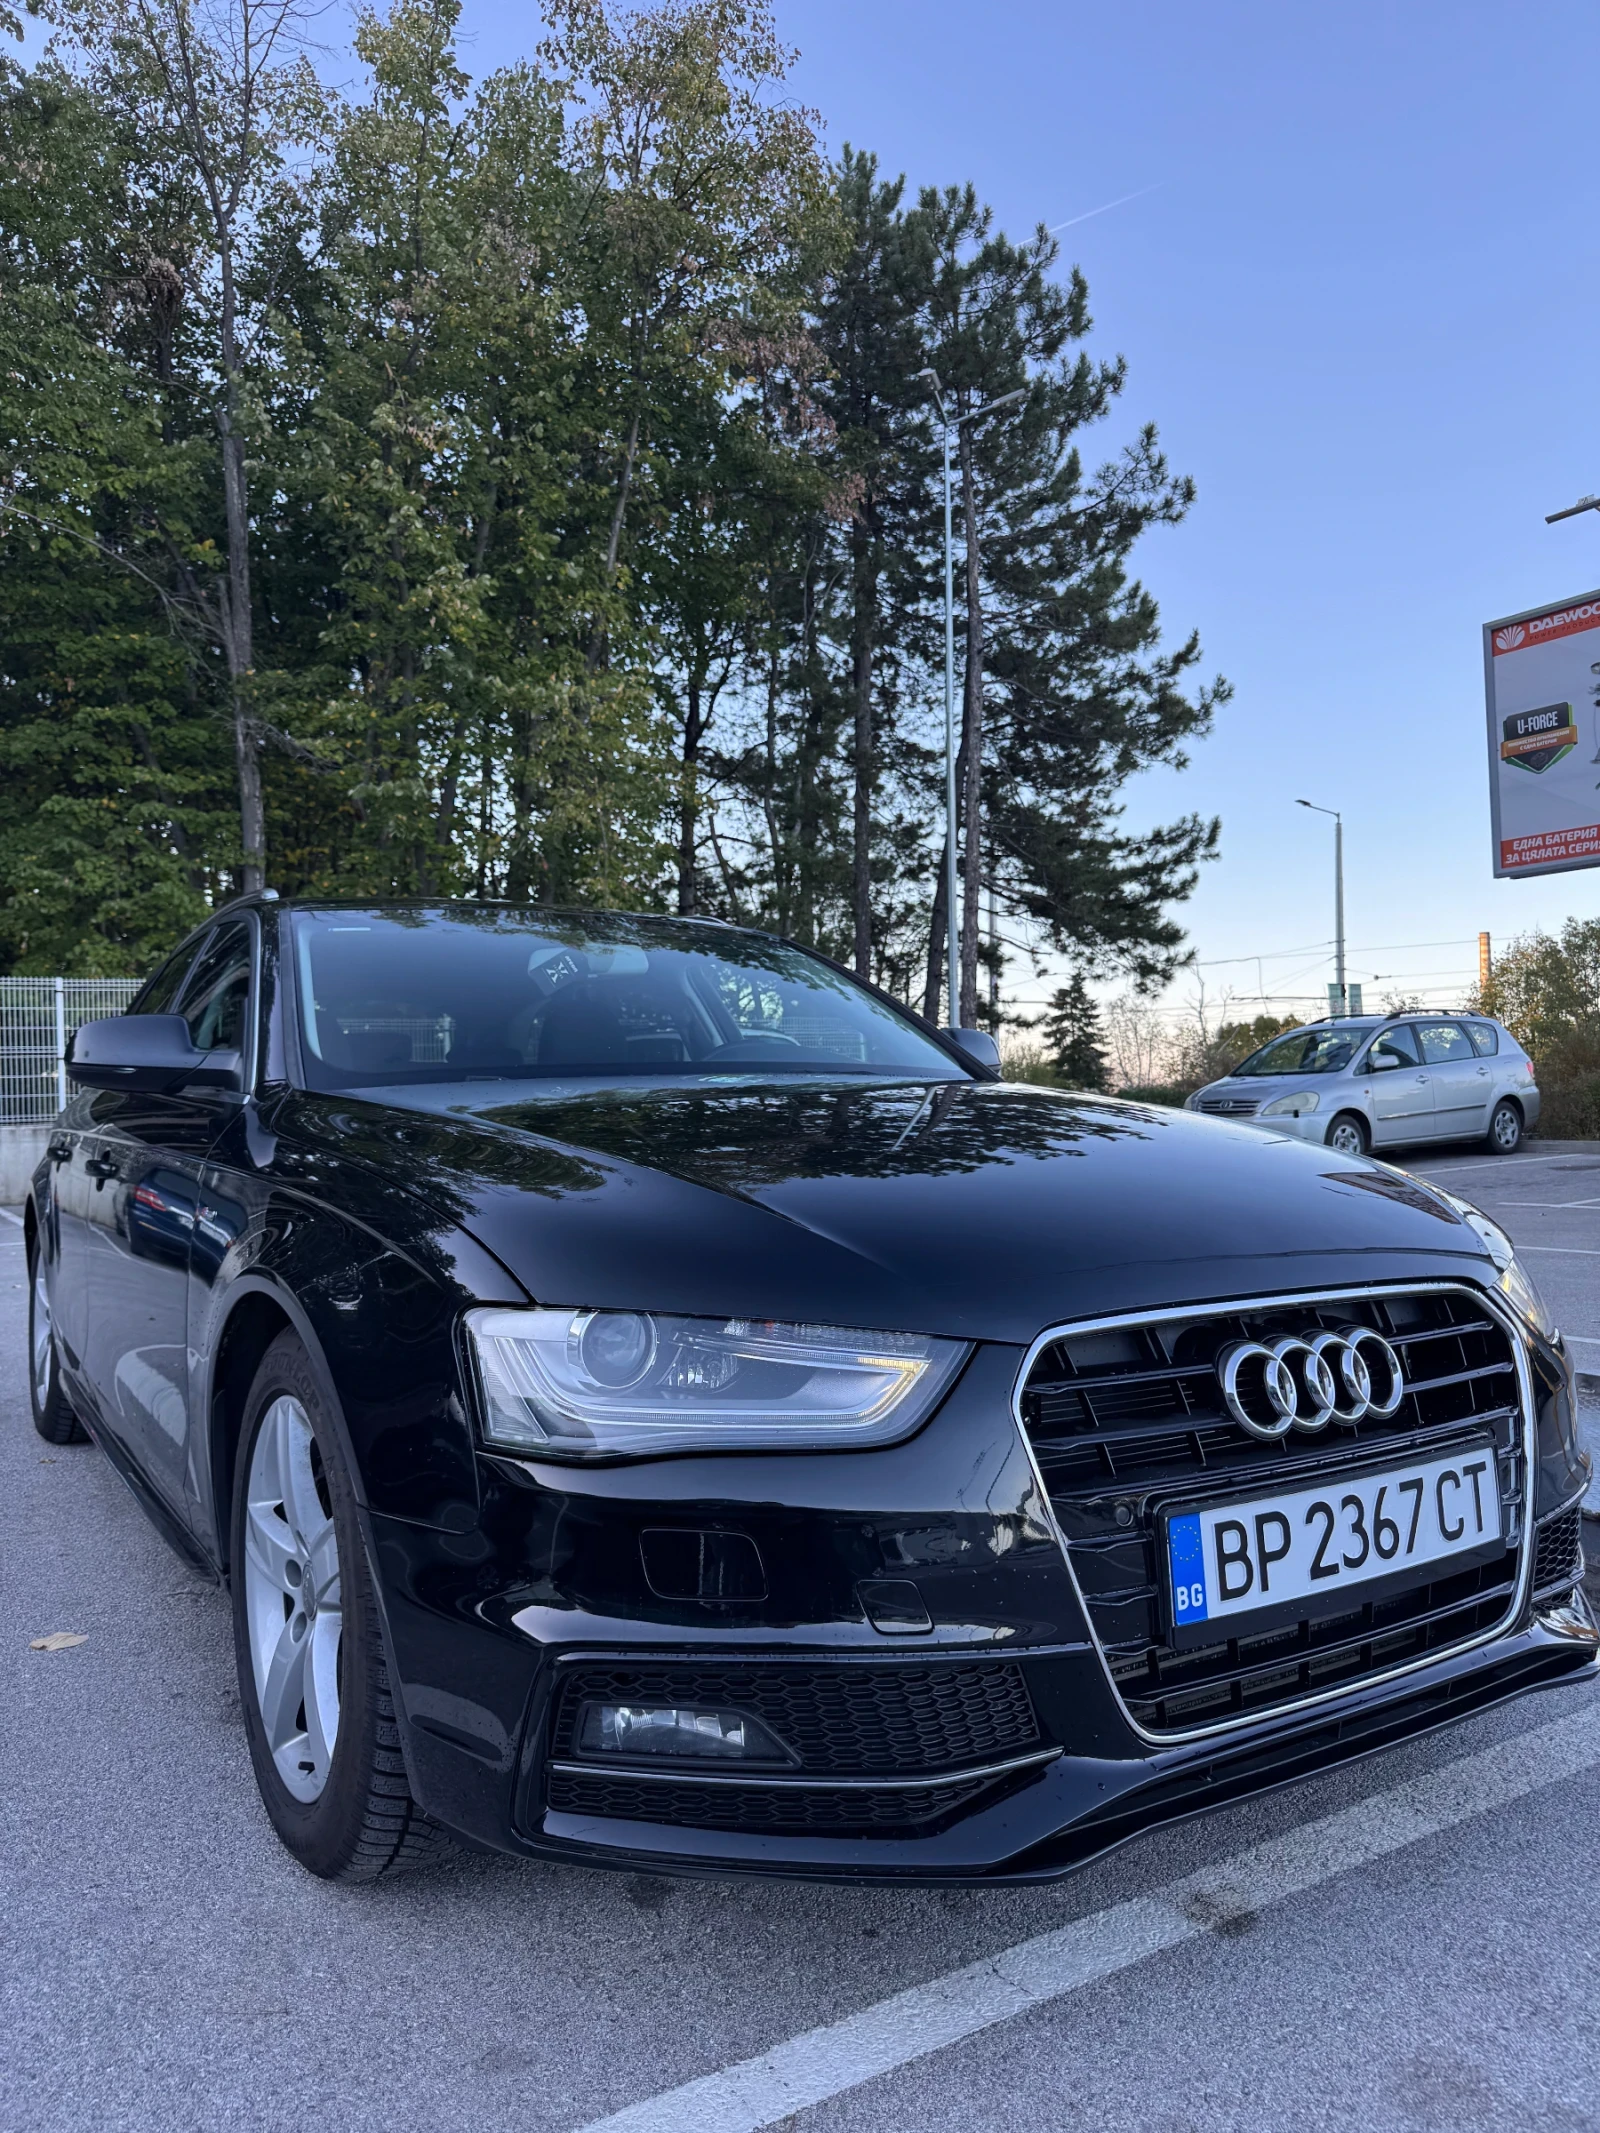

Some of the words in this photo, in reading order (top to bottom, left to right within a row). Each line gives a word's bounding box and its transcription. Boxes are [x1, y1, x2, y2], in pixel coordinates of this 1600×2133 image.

[1530, 629, 1557, 640] POWER
[1517, 711, 1558, 734] U-FORCE
[1513, 837, 1543, 851] ЕДНА
[1545, 827, 1598, 845] БАТЕРИЯ
[1506, 854, 1519, 863] ЗА
[1522, 846, 1566, 862] ЦЯЛАТА
[1568, 840, 1600, 854] СЕРИ
[1214, 1510, 1292, 1602] BP
[1305, 1476, 1424, 1580] 2367
[1436, 1460, 1487, 1542] CT
[1176, 1583, 1204, 1611] BG
